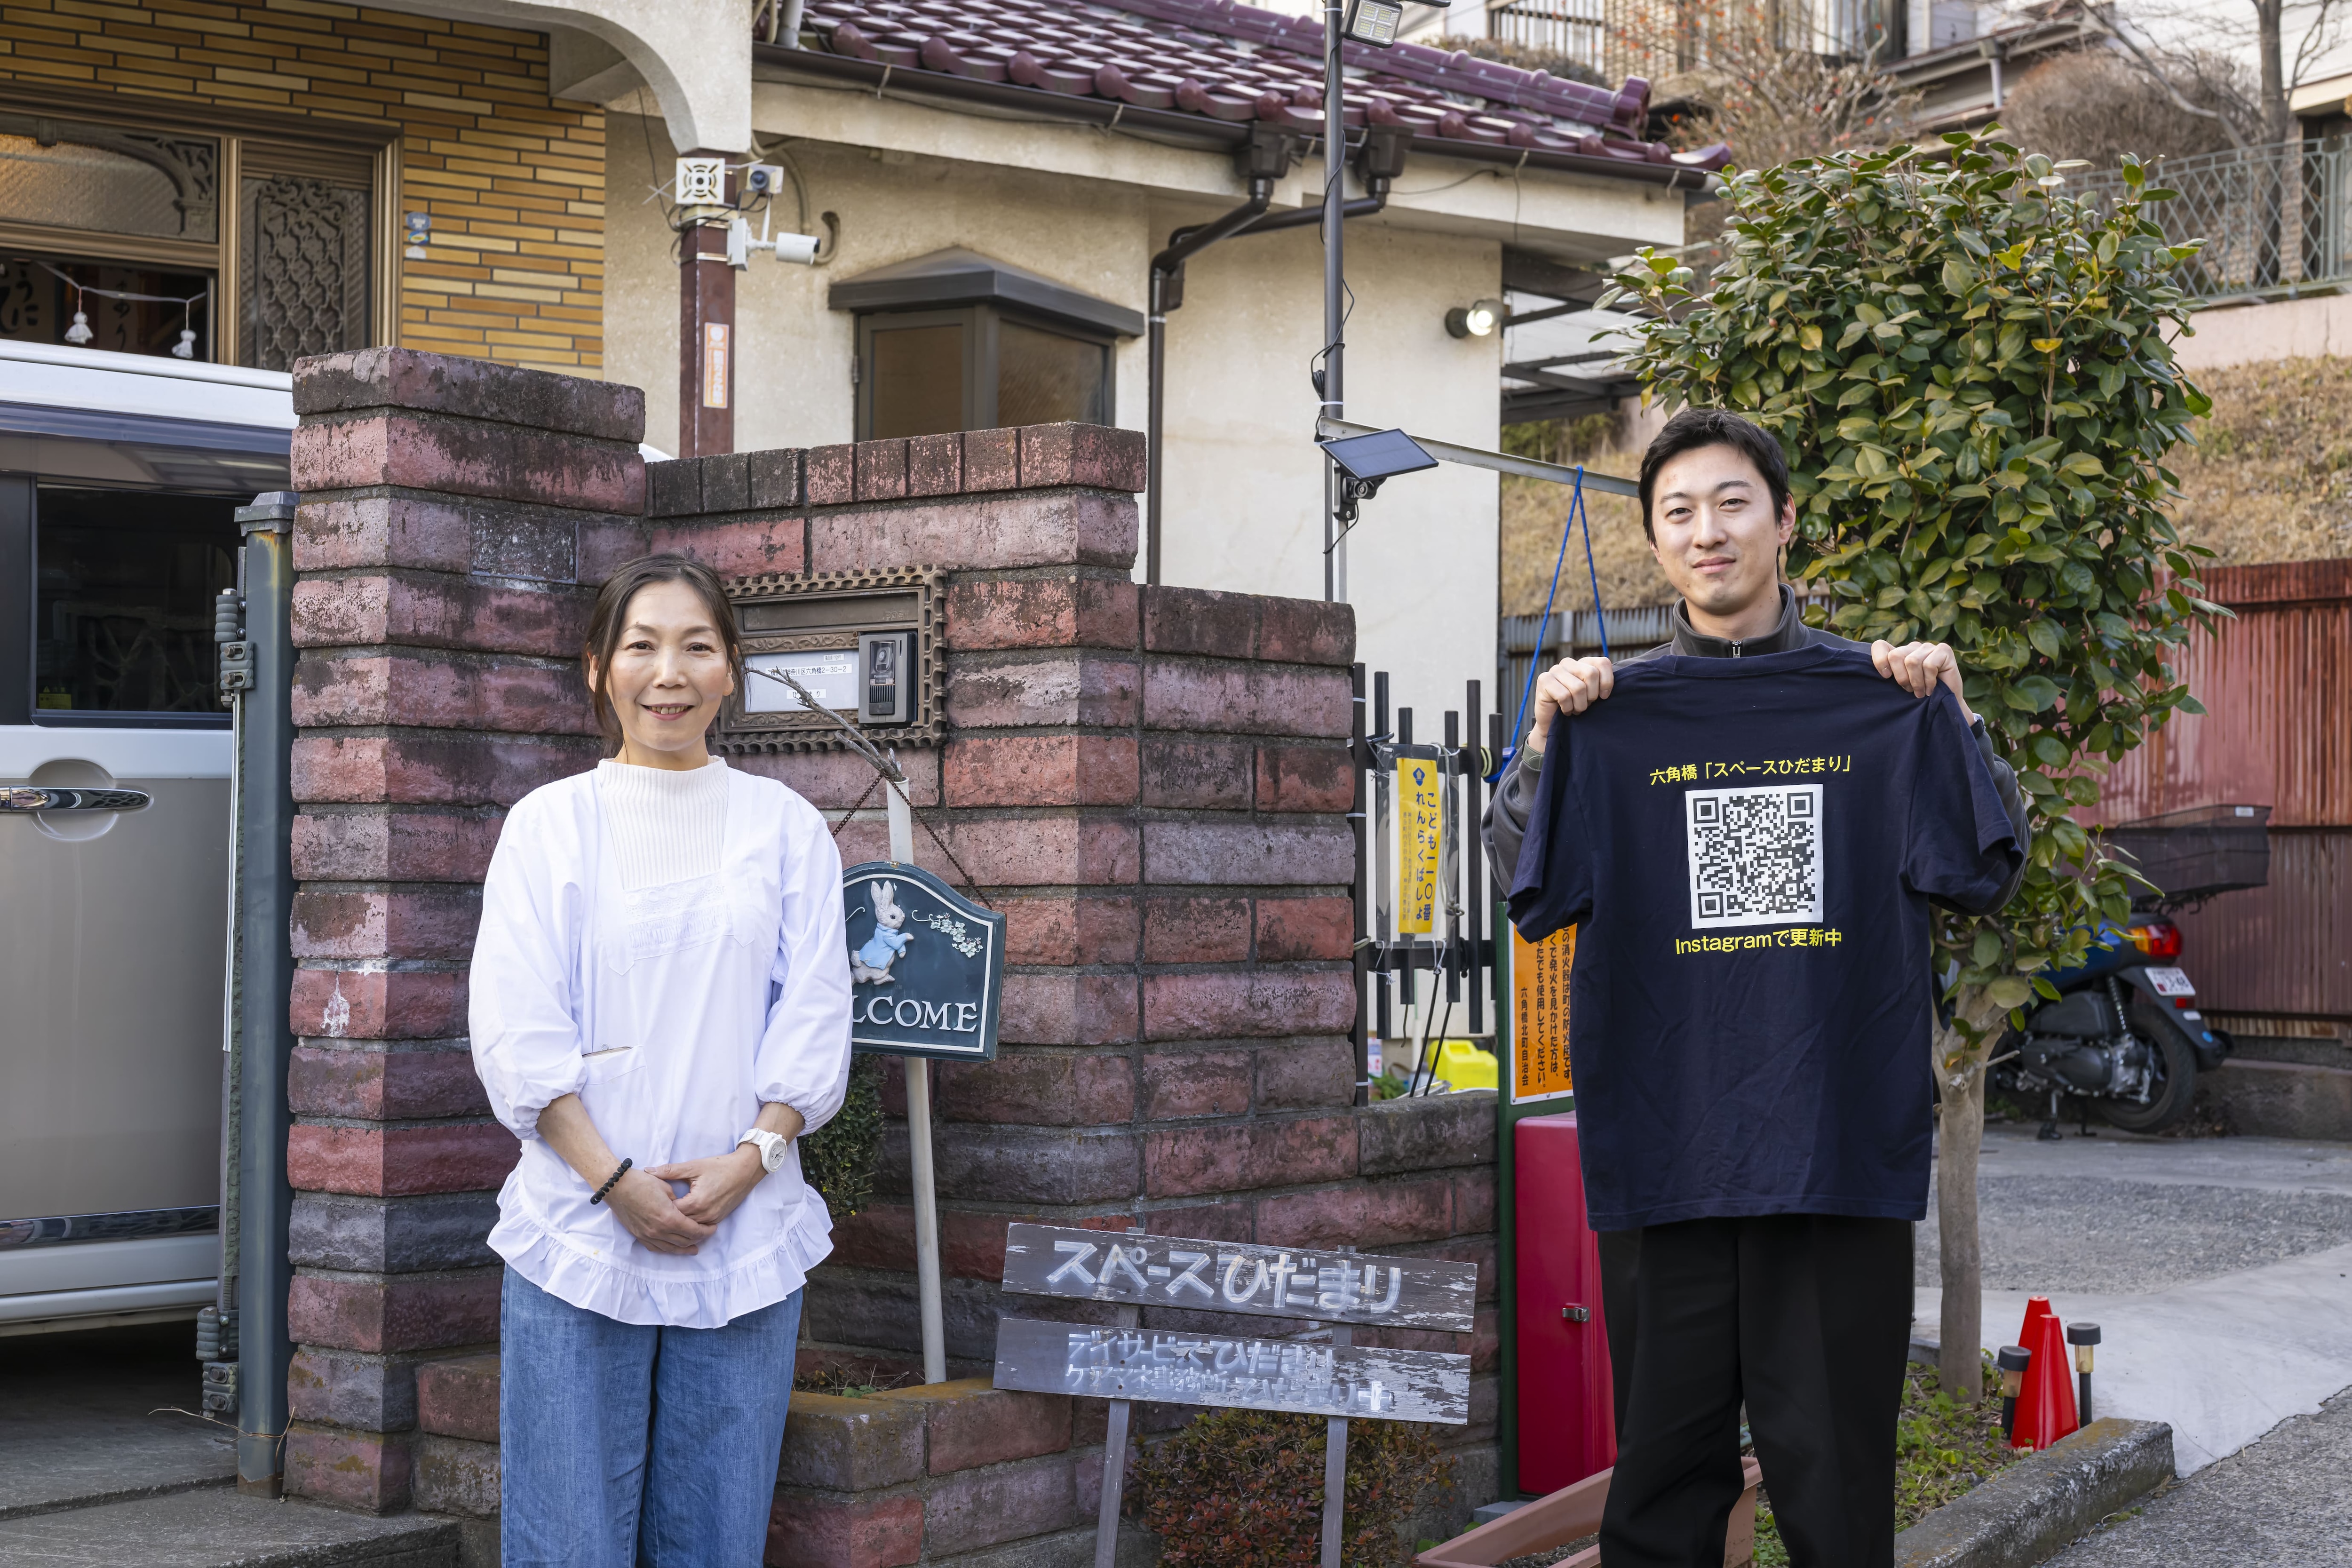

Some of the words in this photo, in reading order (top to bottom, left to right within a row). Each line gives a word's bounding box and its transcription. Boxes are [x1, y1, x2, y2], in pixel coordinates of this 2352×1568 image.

[1649, 755, 1851, 786] 六角橋「スペースひだまり」
[1416, 791, 1426, 920] れんらくばしょ
[1676, 928, 1842, 955] Instagramで更新中
[852, 995, 978, 1033] LCOME
[1520, 987, 1529, 1086] 六角橋北町自治会
[1549, 931, 1558, 1077] くで発火を見かけた方は、
[1046, 1240, 1401, 1314] スペースひだまり
